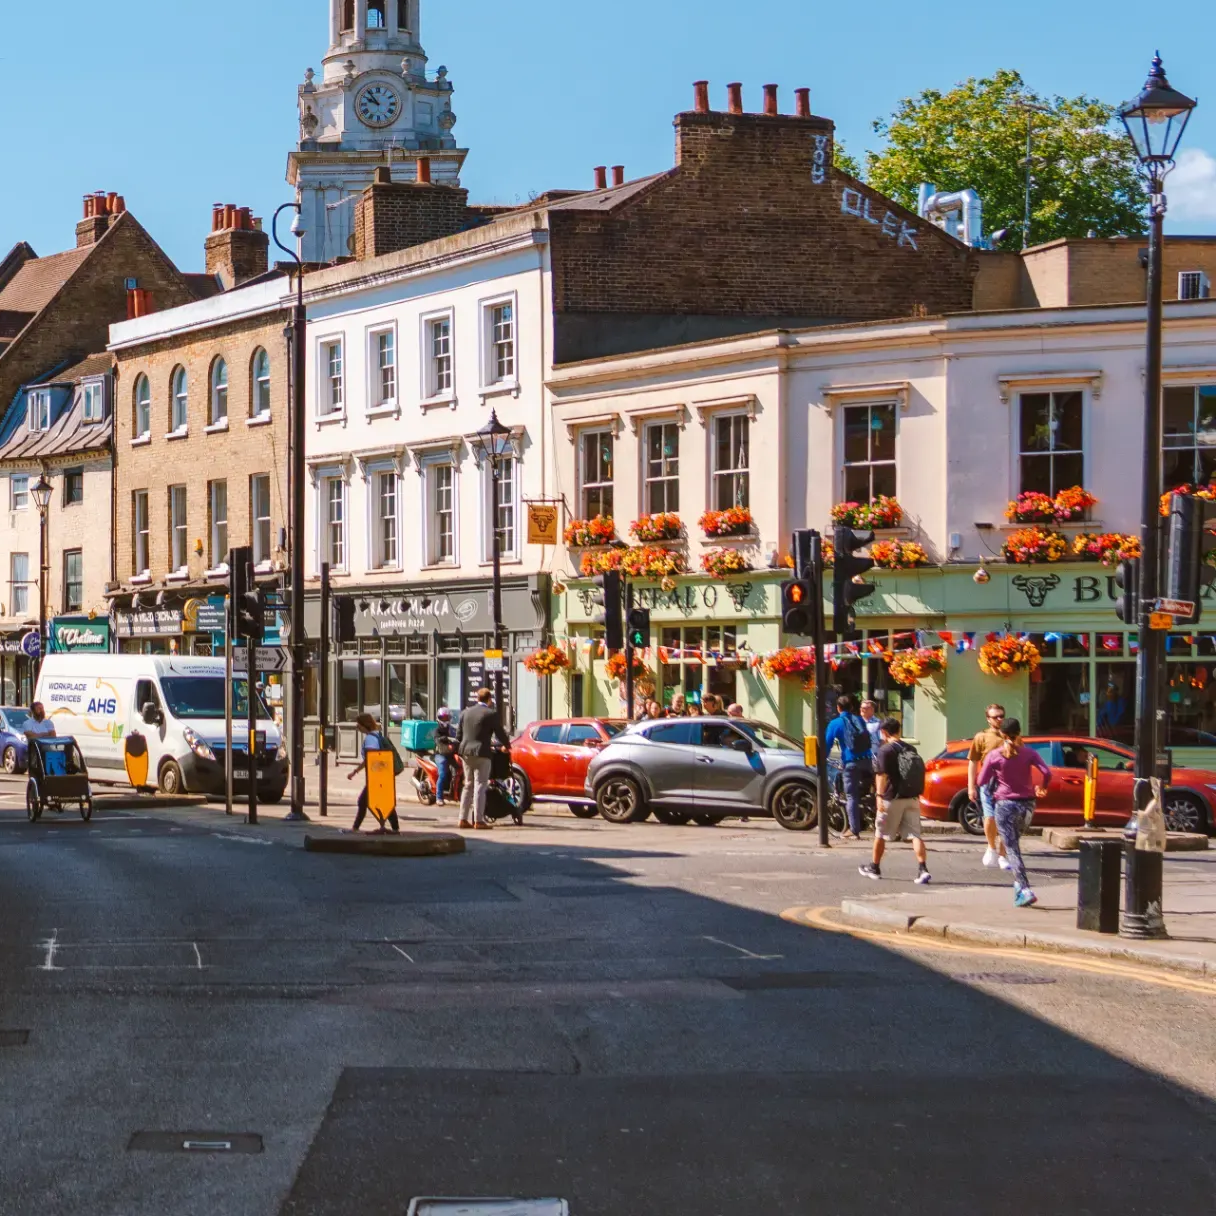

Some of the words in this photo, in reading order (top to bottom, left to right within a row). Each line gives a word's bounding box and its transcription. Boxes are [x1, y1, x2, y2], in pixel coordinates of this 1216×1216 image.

[48, 682, 88, 691] WORKPLACE
[50, 694, 82, 702] SERVICES
[87, 697, 117, 714] AHS
